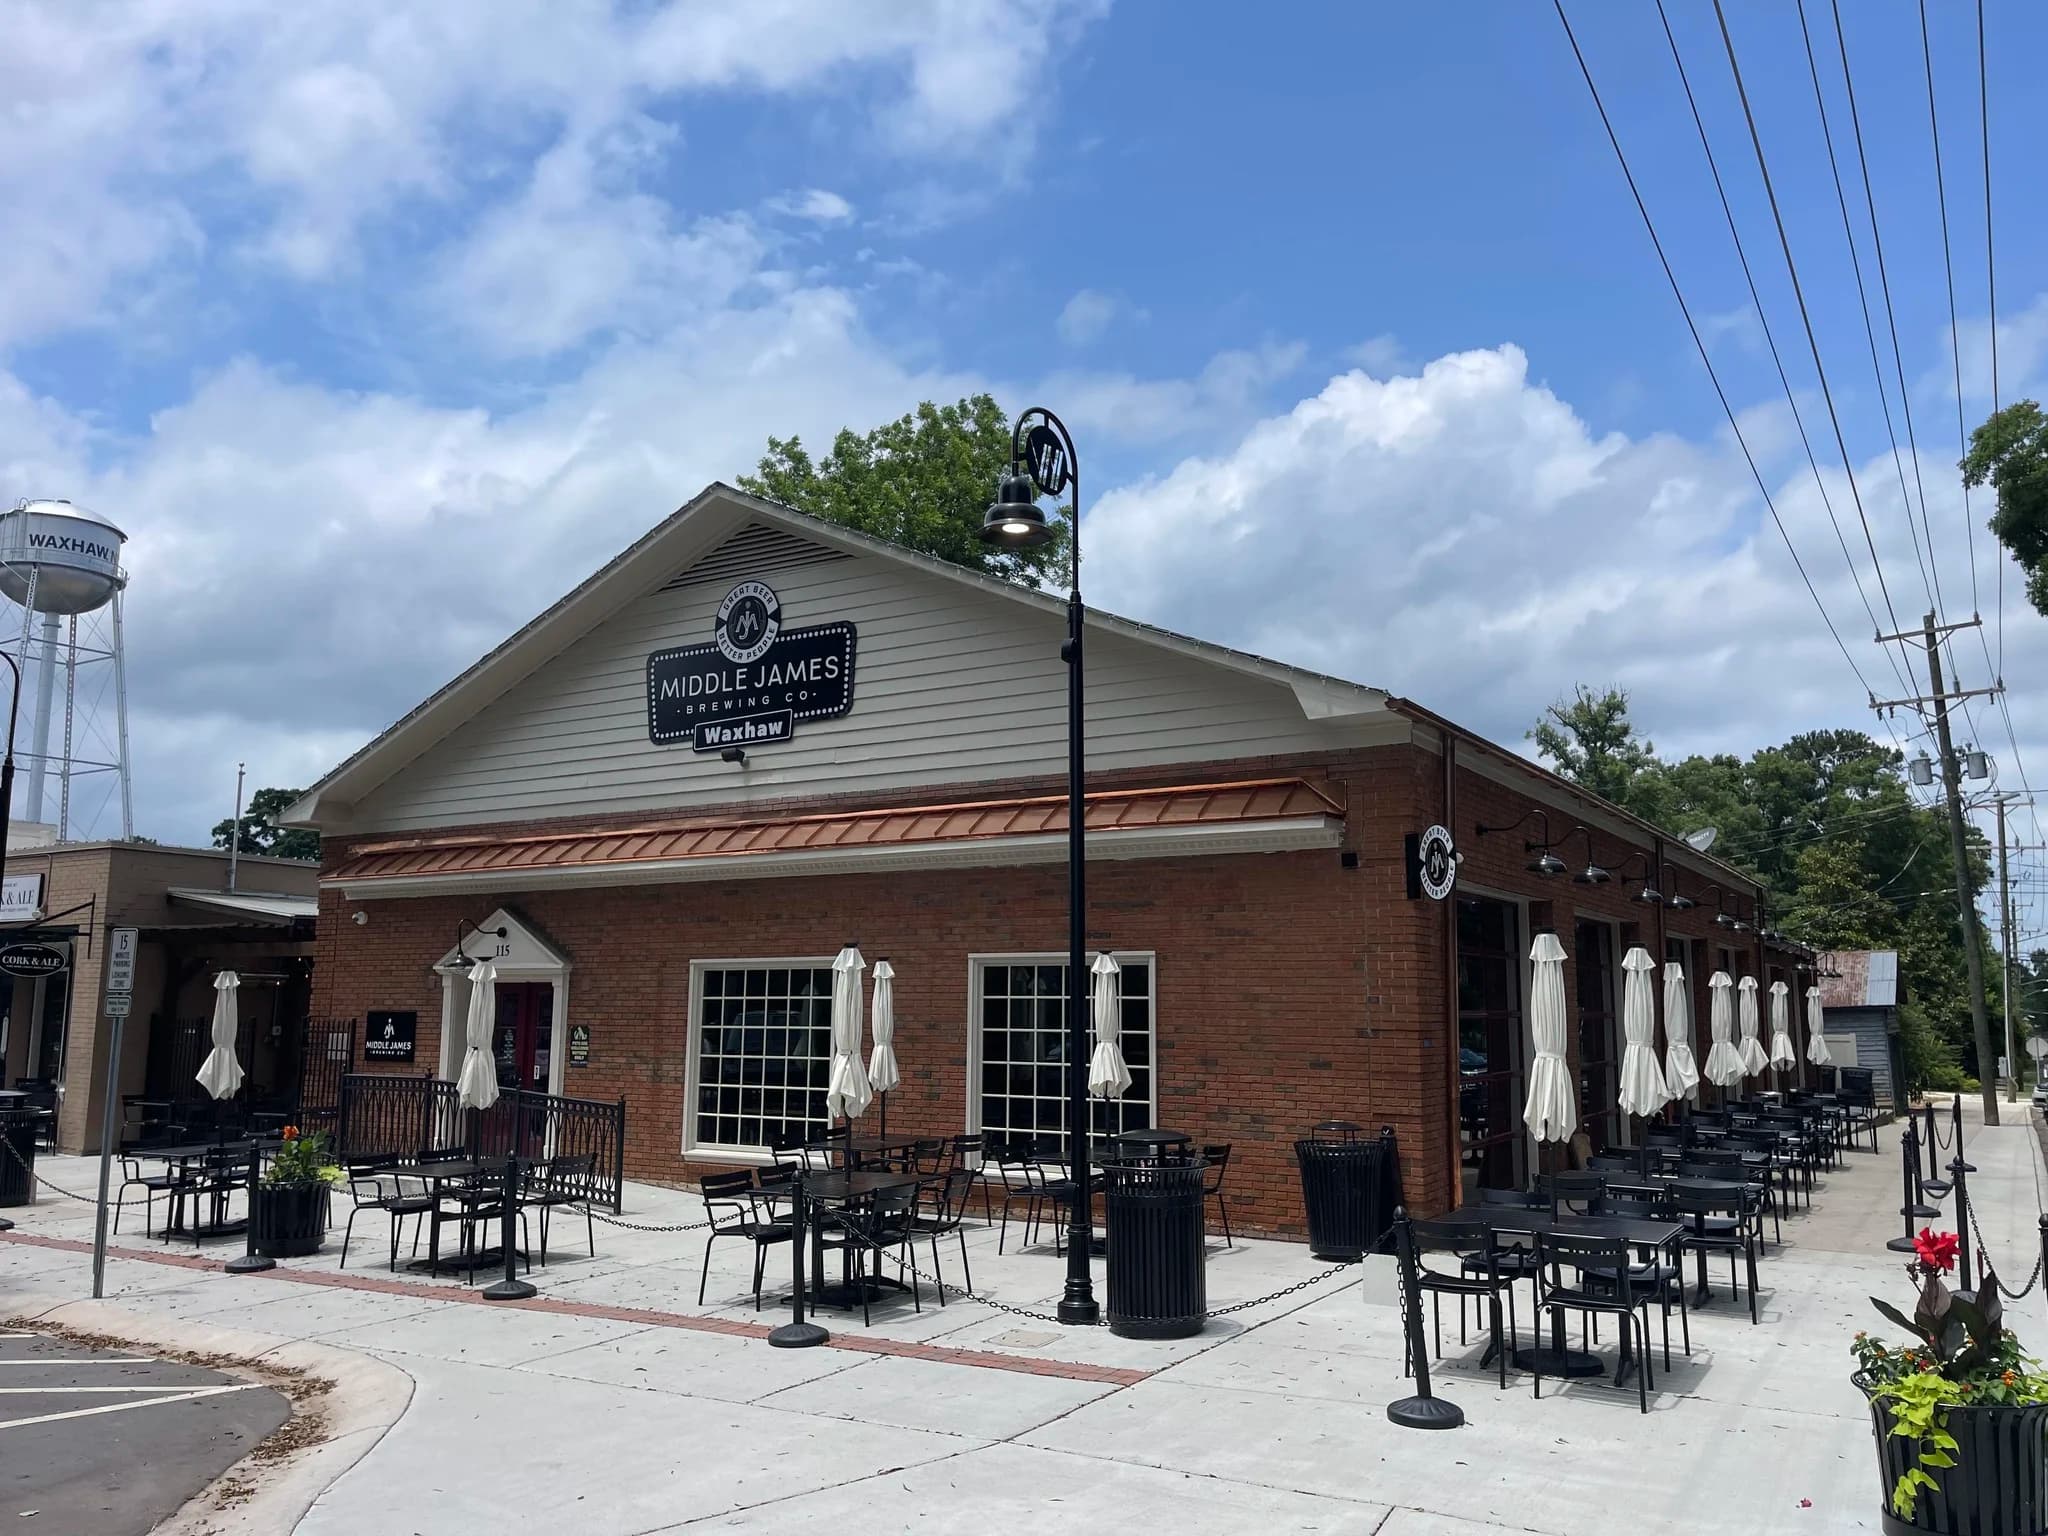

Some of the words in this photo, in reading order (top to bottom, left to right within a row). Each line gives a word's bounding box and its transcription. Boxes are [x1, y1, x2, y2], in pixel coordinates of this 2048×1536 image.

[29, 533, 109, 561] WAXHAW
[723, 585, 750, 610] GREAT
[753, 585, 774, 605] BEER
[718, 632, 743, 660] BETTER
[746, 627, 775, 660] PEOPLE
[660, 668, 748, 700] MIDDLE
[753, 655, 839, 688] JAMES
[686, 695, 770, 714] BREWING
[704, 720, 783, 744] Waxhaw
[18, 889, 34, 905] ALE
[120, 934, 129, 950] 15
[495, 944, 510, 957] 115
[2, 955, 30, 965] CORK
[31, 957, 38, 965] &
[40, 957, 60, 967] ALE
[366, 1041, 389, 1049] MIDDLE
[390, 1041, 412, 1050] JAMES
